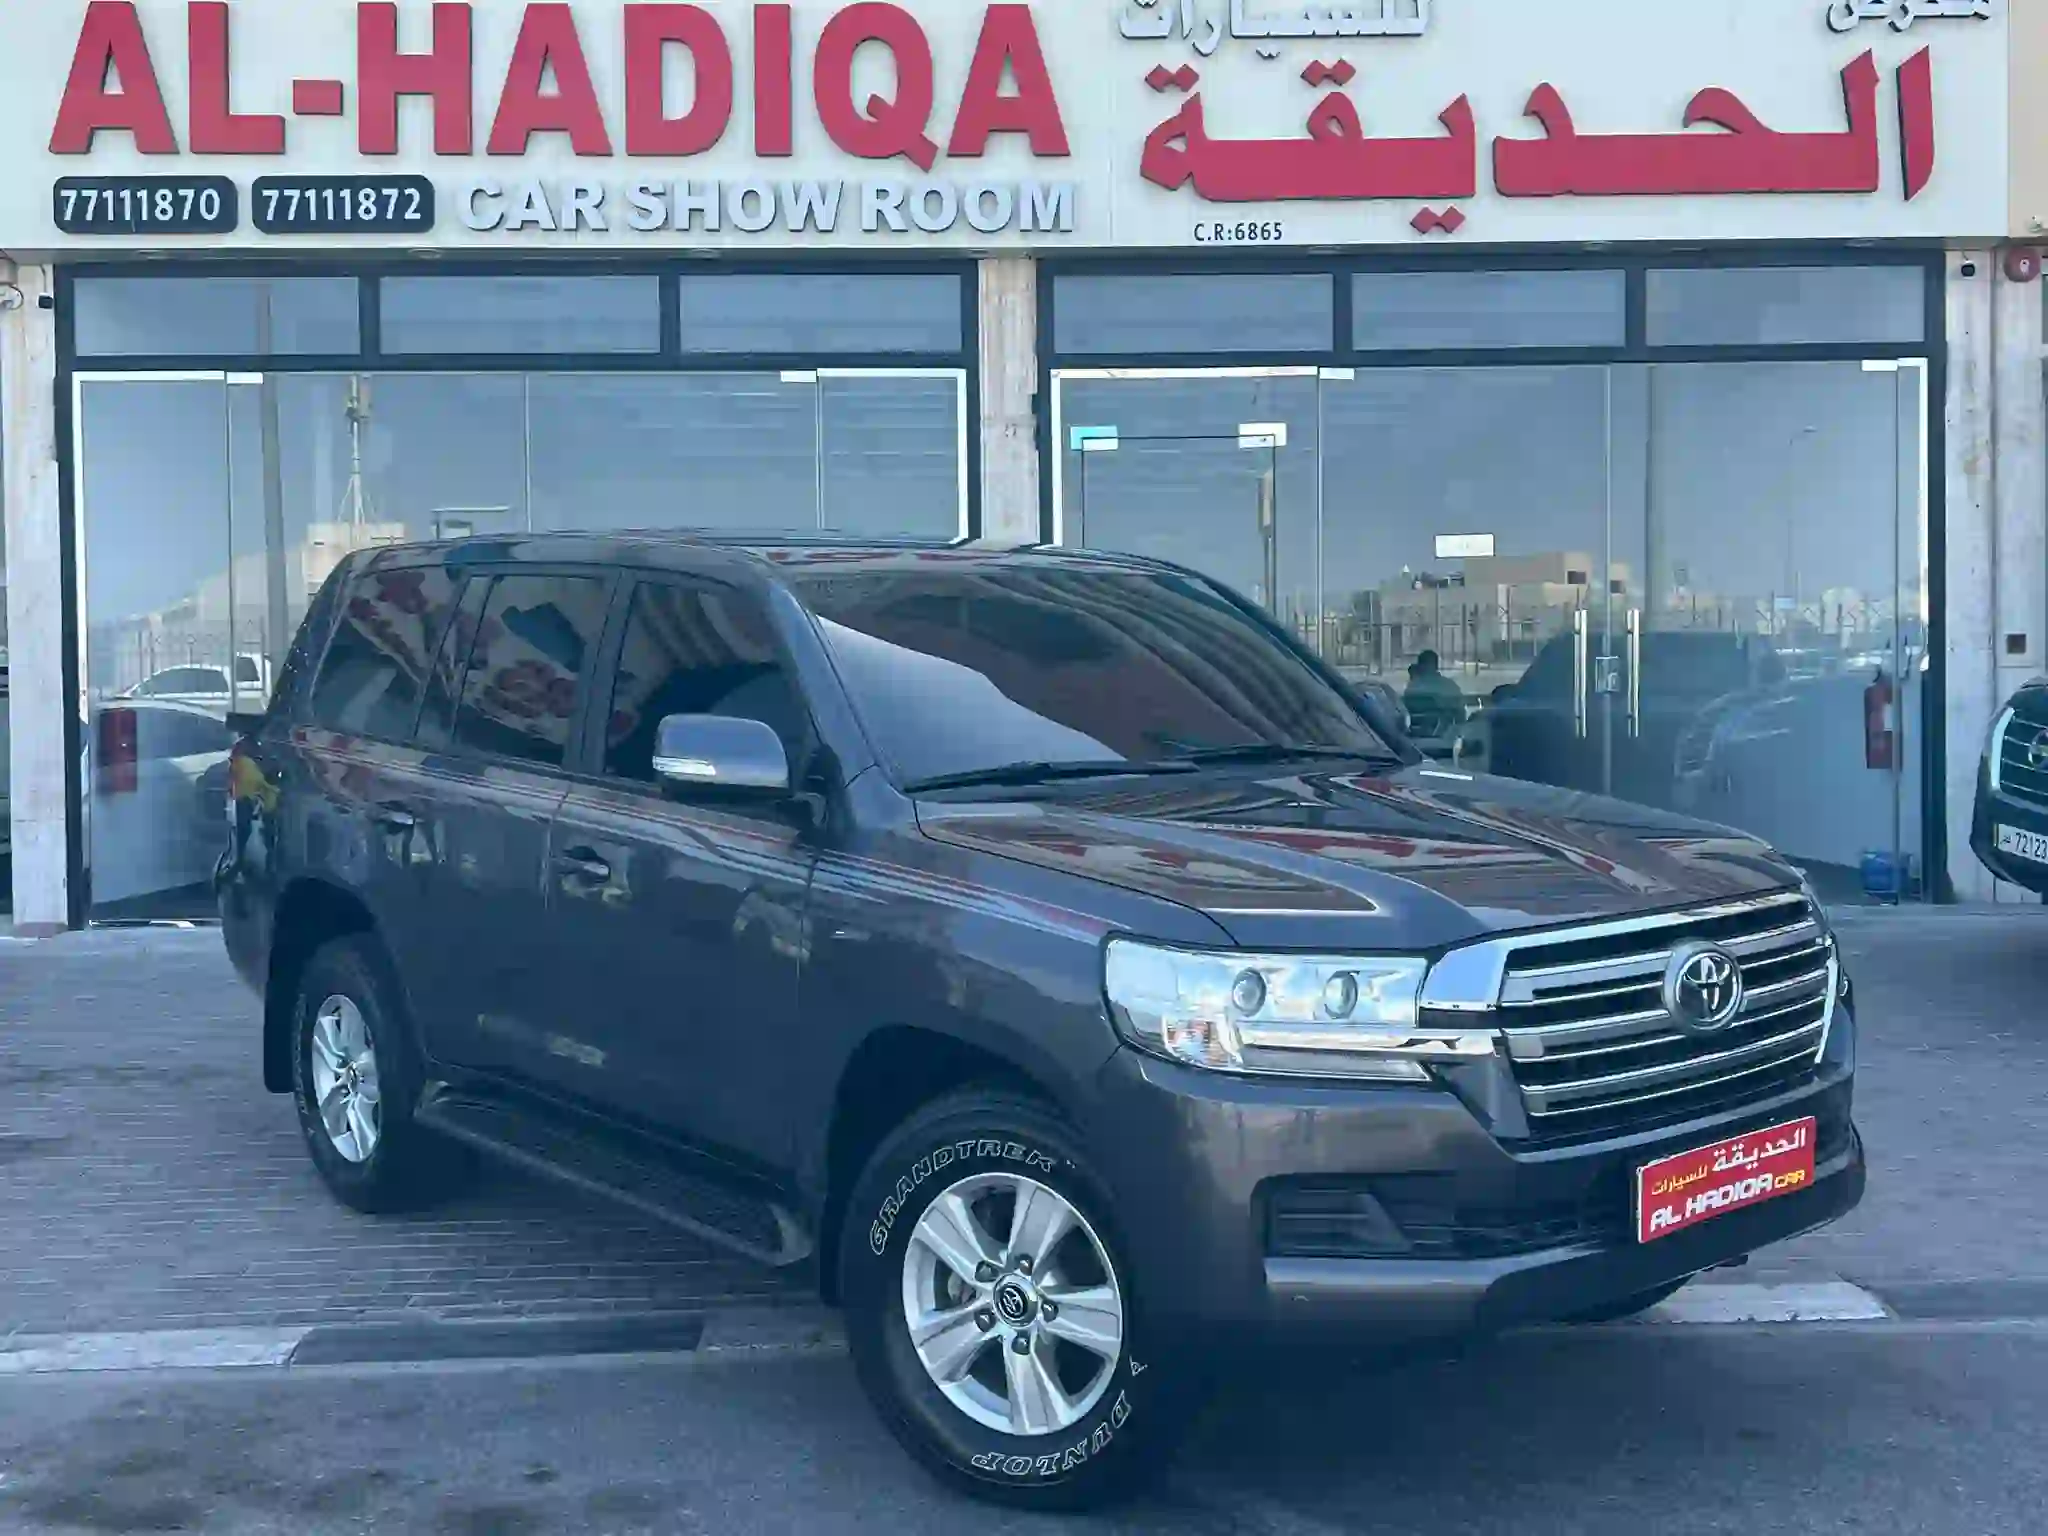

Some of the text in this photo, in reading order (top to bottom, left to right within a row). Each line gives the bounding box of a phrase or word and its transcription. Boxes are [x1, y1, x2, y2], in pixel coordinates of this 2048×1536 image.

[49, 1, 1071, 171] AL-HADIQA
[1140, 45, 1935, 235] الحديقة
[60, 188, 221, 222] 77111870
[262, 188, 422, 221] 77111872
[460, 180, 1075, 233] CAR SHOW ROOM
[1193, 222, 1283, 242] C.R:6865
[1712, 1127, 1806, 1171] الحديقة
[869, 1139, 1056, 1256] GRANDTREK
[1650, 1205, 1682, 1233] AL
[1774, 1169, 1805, 1189] CAR
[971, 1389, 1132, 1476] DUNLOP
